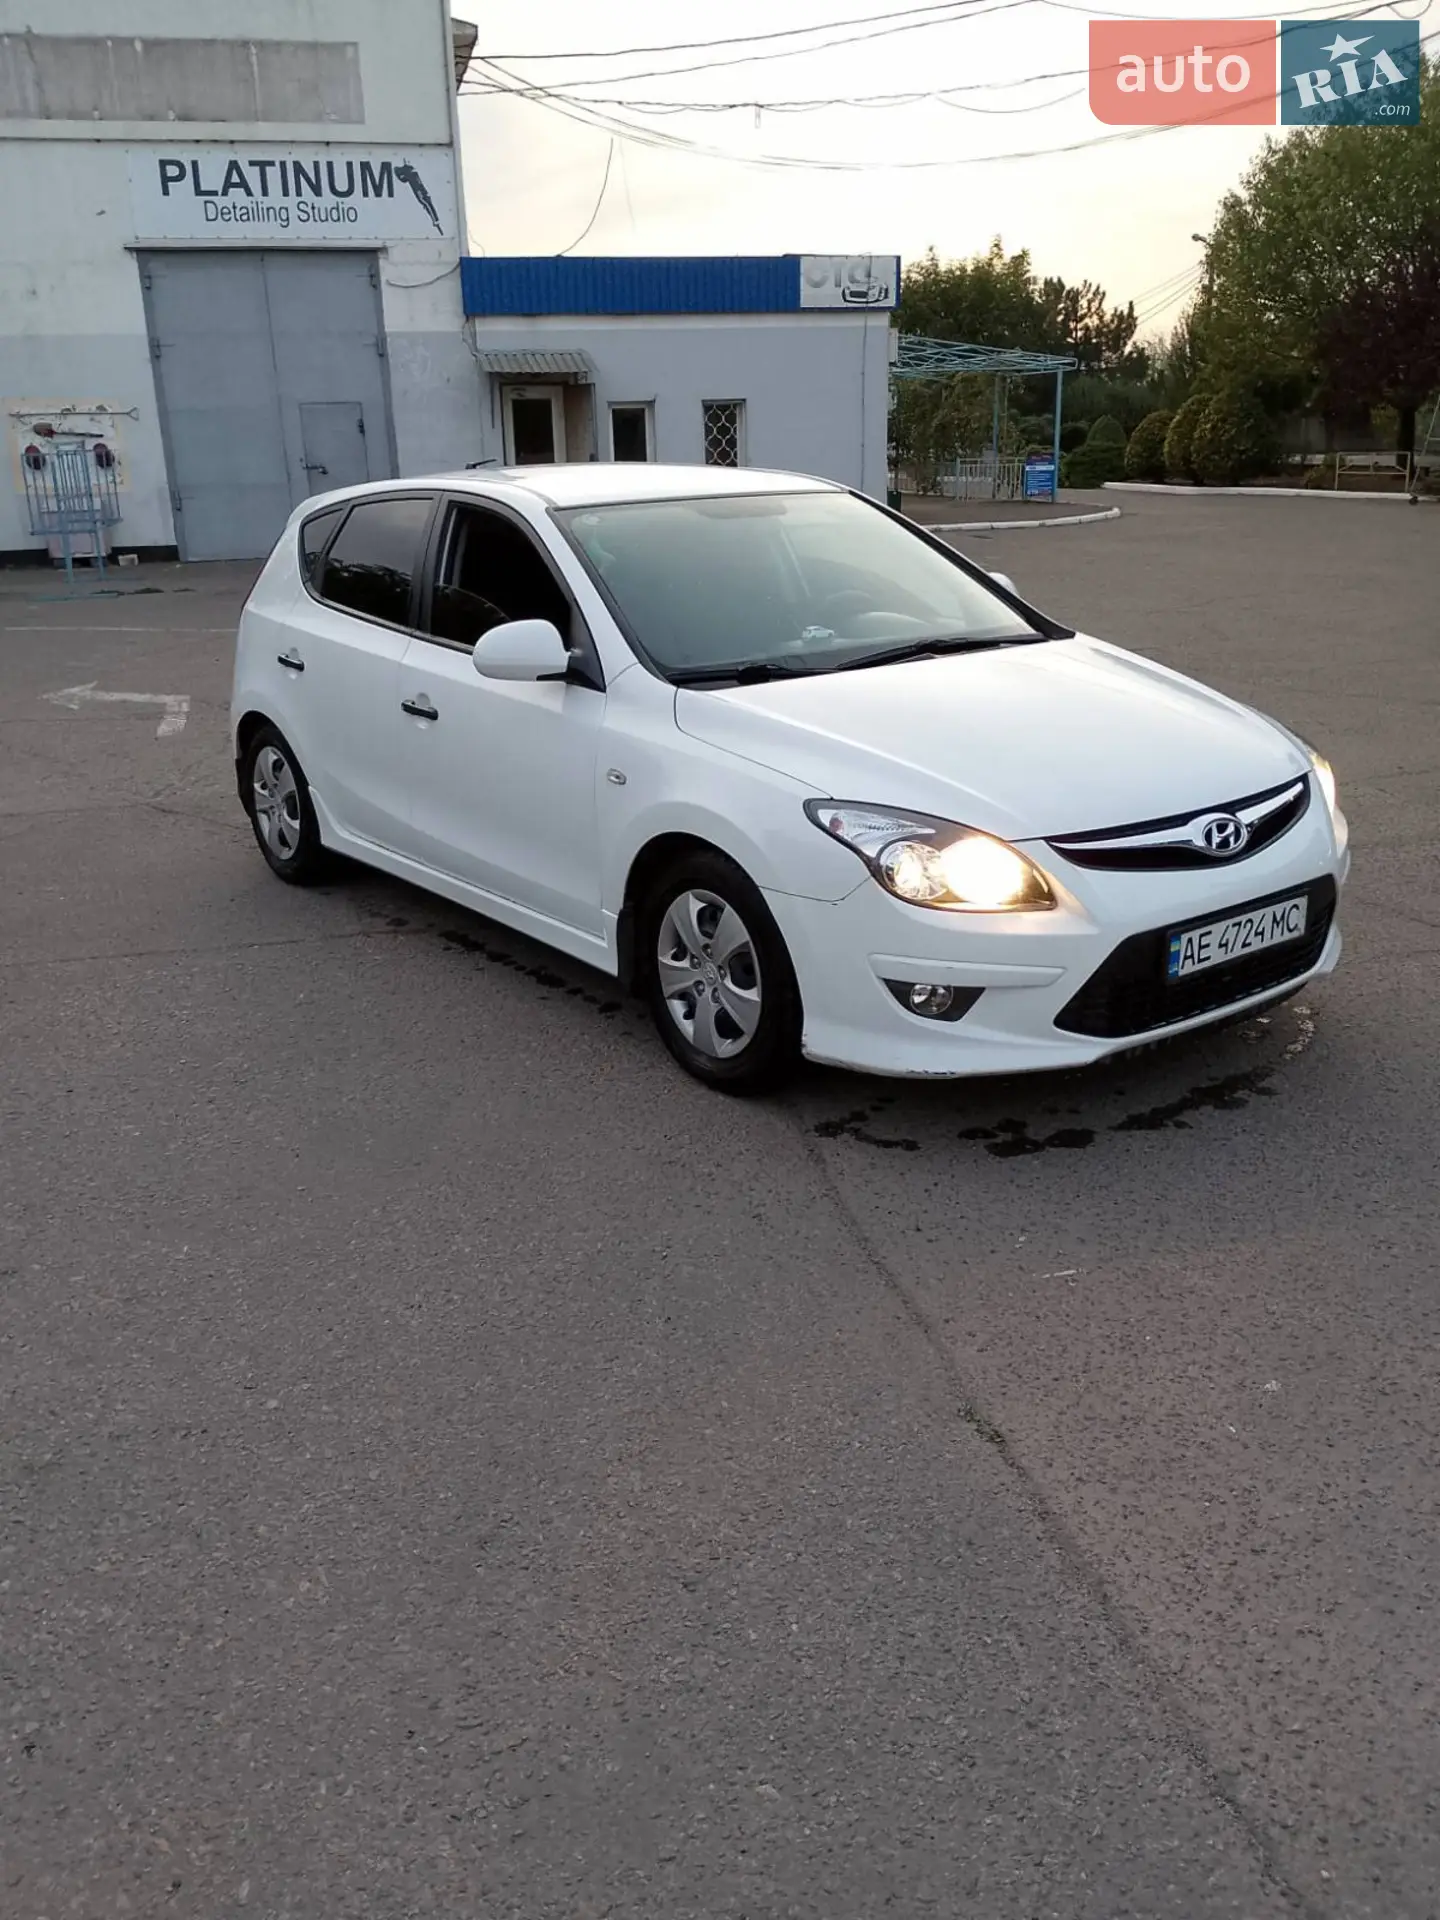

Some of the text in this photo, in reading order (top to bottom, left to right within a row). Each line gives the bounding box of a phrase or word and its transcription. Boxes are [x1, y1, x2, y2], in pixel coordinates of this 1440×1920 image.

[158, 158, 395, 199] PLATINUM
[203, 200, 358, 228] Detailing Studio
[1180, 903, 1300, 970] AE 4724 MC
